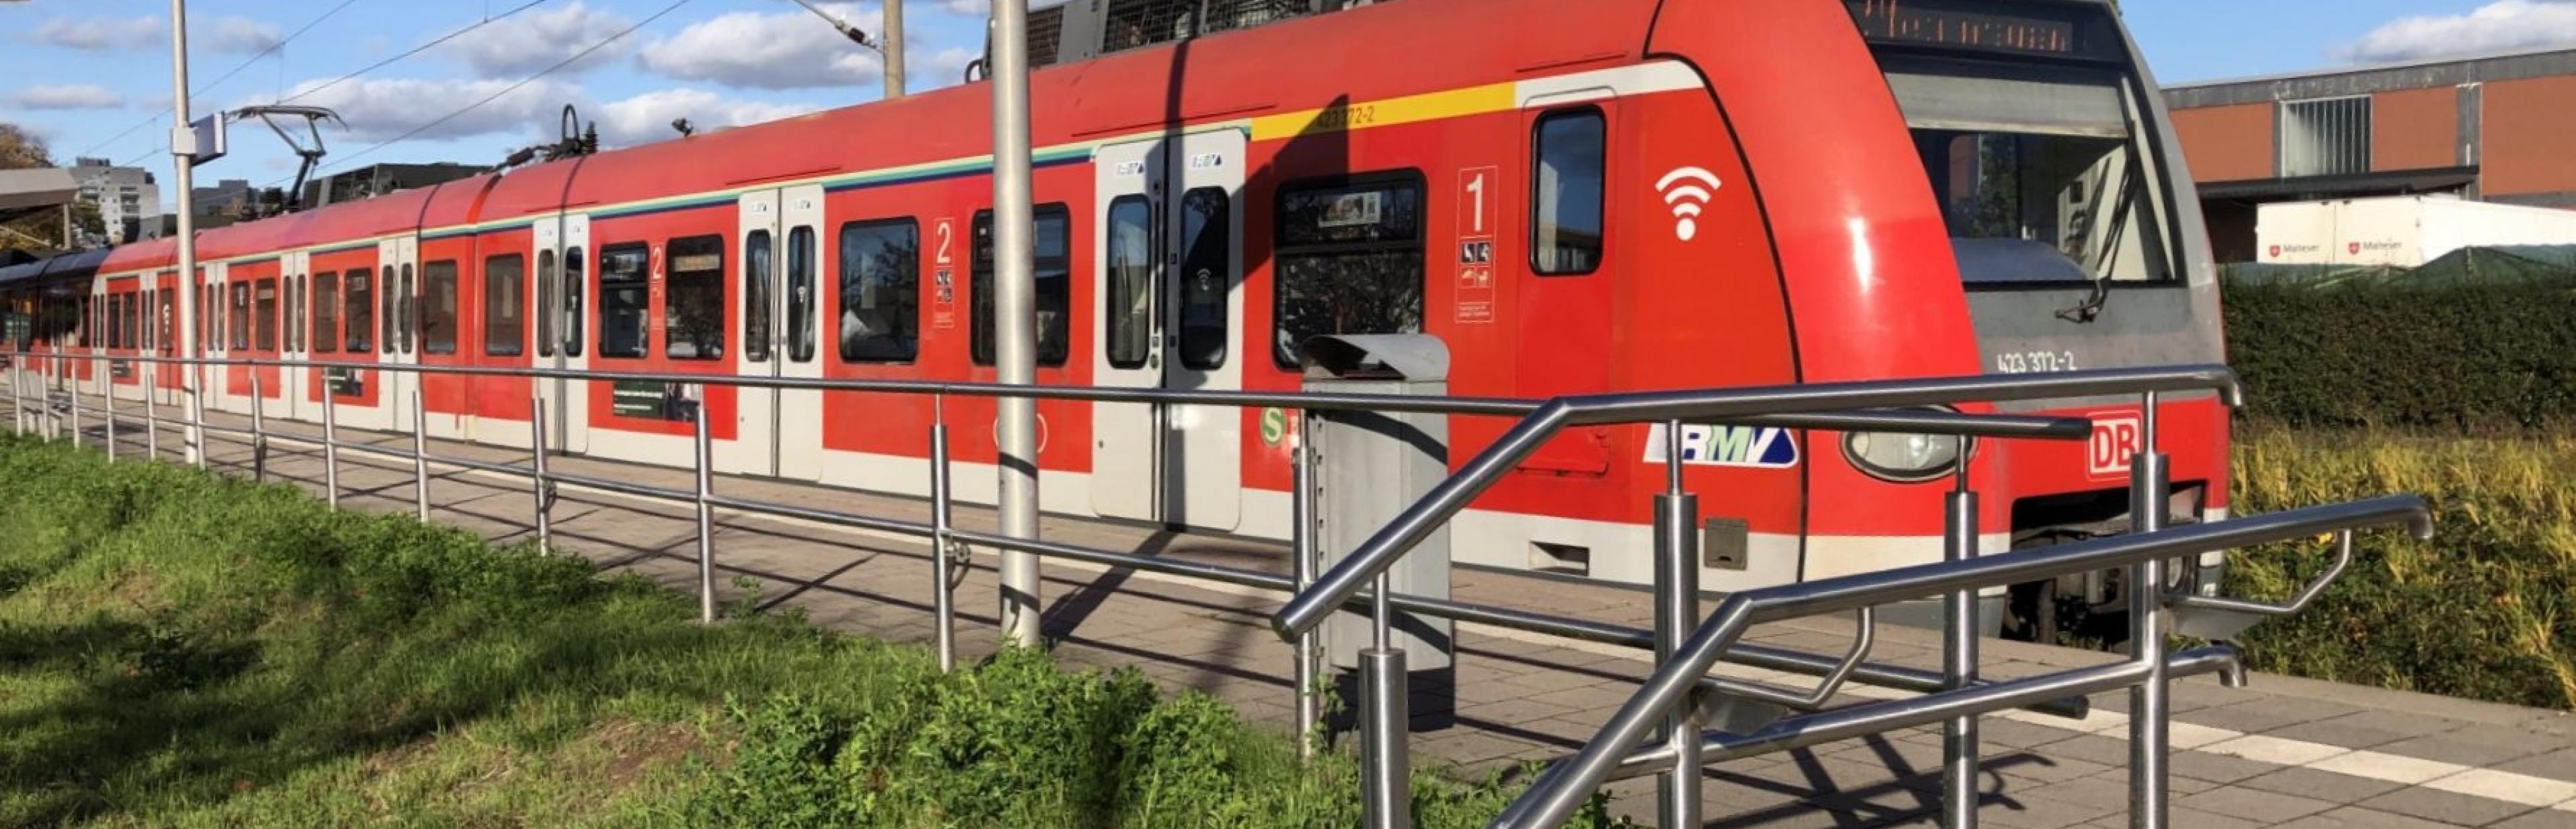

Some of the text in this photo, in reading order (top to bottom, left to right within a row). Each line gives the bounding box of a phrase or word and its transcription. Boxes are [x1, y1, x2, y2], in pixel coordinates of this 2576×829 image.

[1466, 172, 1484, 231] 1
[936, 221, 951, 264] 2
[653, 246, 661, 280] 2
[1997, 350, 2077, 373] 423 372-2
[1265, 406, 1282, 443] S
[1678, 424, 1782, 463] RMV
[2093, 423, 2136, 468] DB
